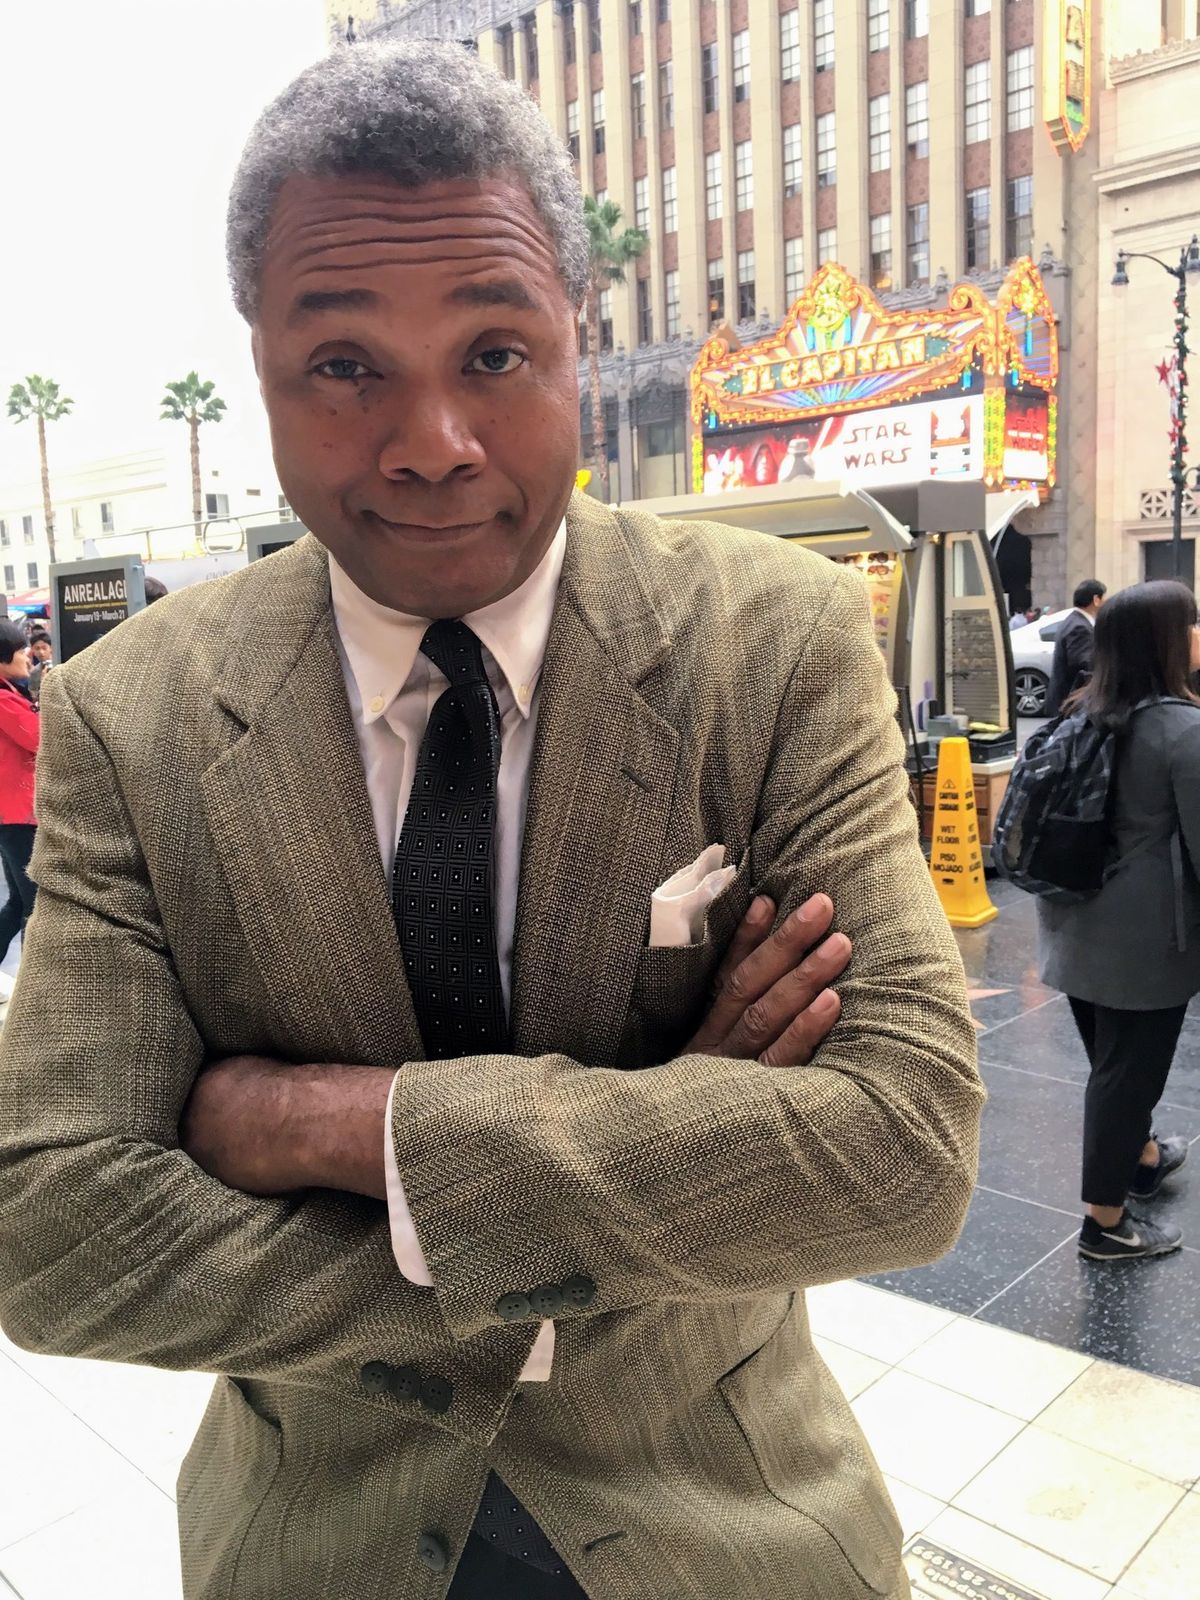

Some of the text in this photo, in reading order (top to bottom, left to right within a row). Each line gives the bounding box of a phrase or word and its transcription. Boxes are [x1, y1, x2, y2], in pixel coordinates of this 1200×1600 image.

[781, 336, 925, 387] CAPITAN
[842, 422, 912, 445] STAR
[844, 449, 910, 471] WARS
[74, 613, 93, 623] January
[102, 610, 118, 620] March
[120, 610, 125, 619] 21
[941, 825, 956, 834] WET
[936, 836, 960, 845] FLOOR
[940, 853, 956, 862] PISO
[933, 864, 963, 874] MOJADO
[911, 1545, 954, 1570] 1999
